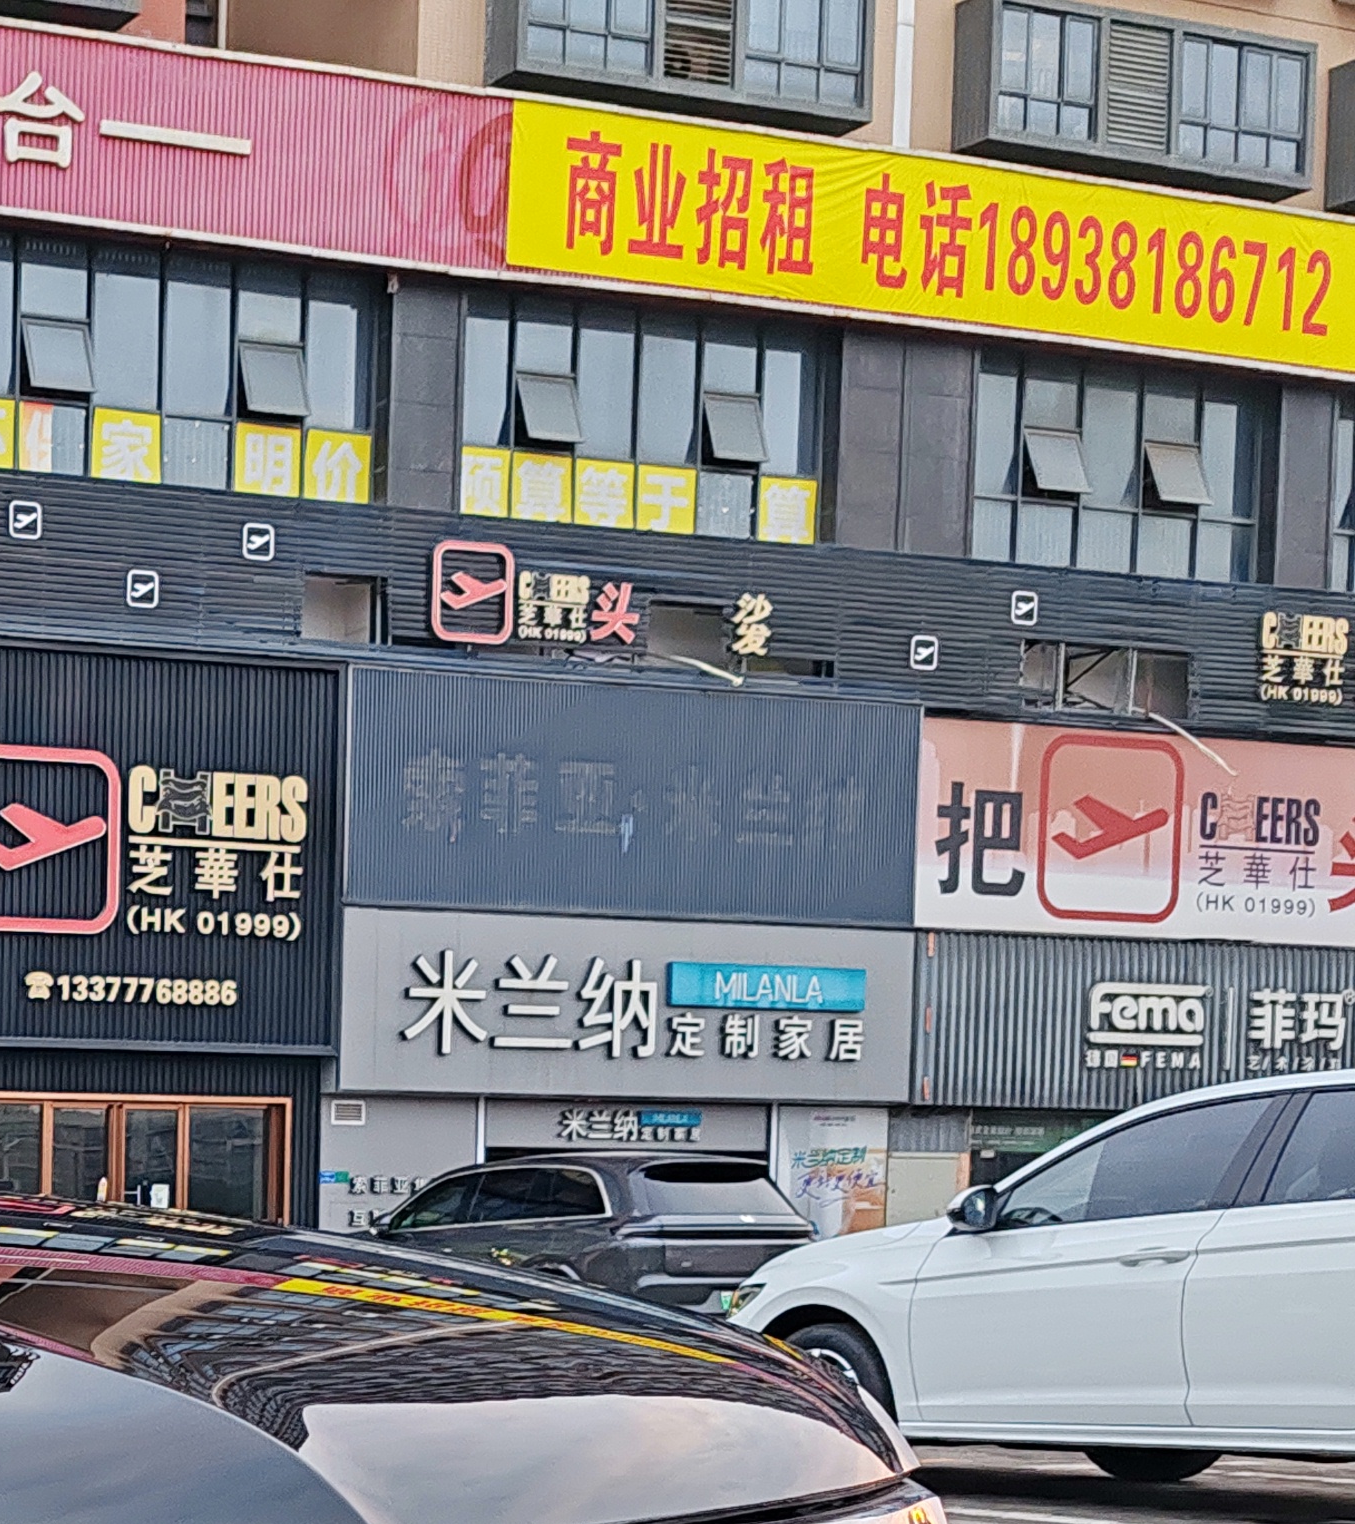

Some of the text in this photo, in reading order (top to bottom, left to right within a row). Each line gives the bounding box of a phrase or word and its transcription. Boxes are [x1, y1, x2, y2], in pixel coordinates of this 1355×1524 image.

[565, 131, 1332, 337] 商业招租 电话18938186712
[590, 582, 640, 644] 头
[935, 782, 1025, 898] 把
[127, 847, 303, 901] 芝華仕
[1198, 853, 1317, 891] 芝華仕
[126, 905, 302, 941] (HK 01999)
[1196, 892, 1316, 918] (HK 01999)
[57, 976, 238, 1006] 13377768886
[402, 950, 658, 1056] 米兰纳
[715, 972, 823, 1003] MILANLA
[668, 1014, 864, 1062] 定制家居
[1248, 988, 1346, 1050] 菲玛
[1140, 1050, 1201, 1069] FEMA
[561, 1109, 638, 1141] 米兰纳
